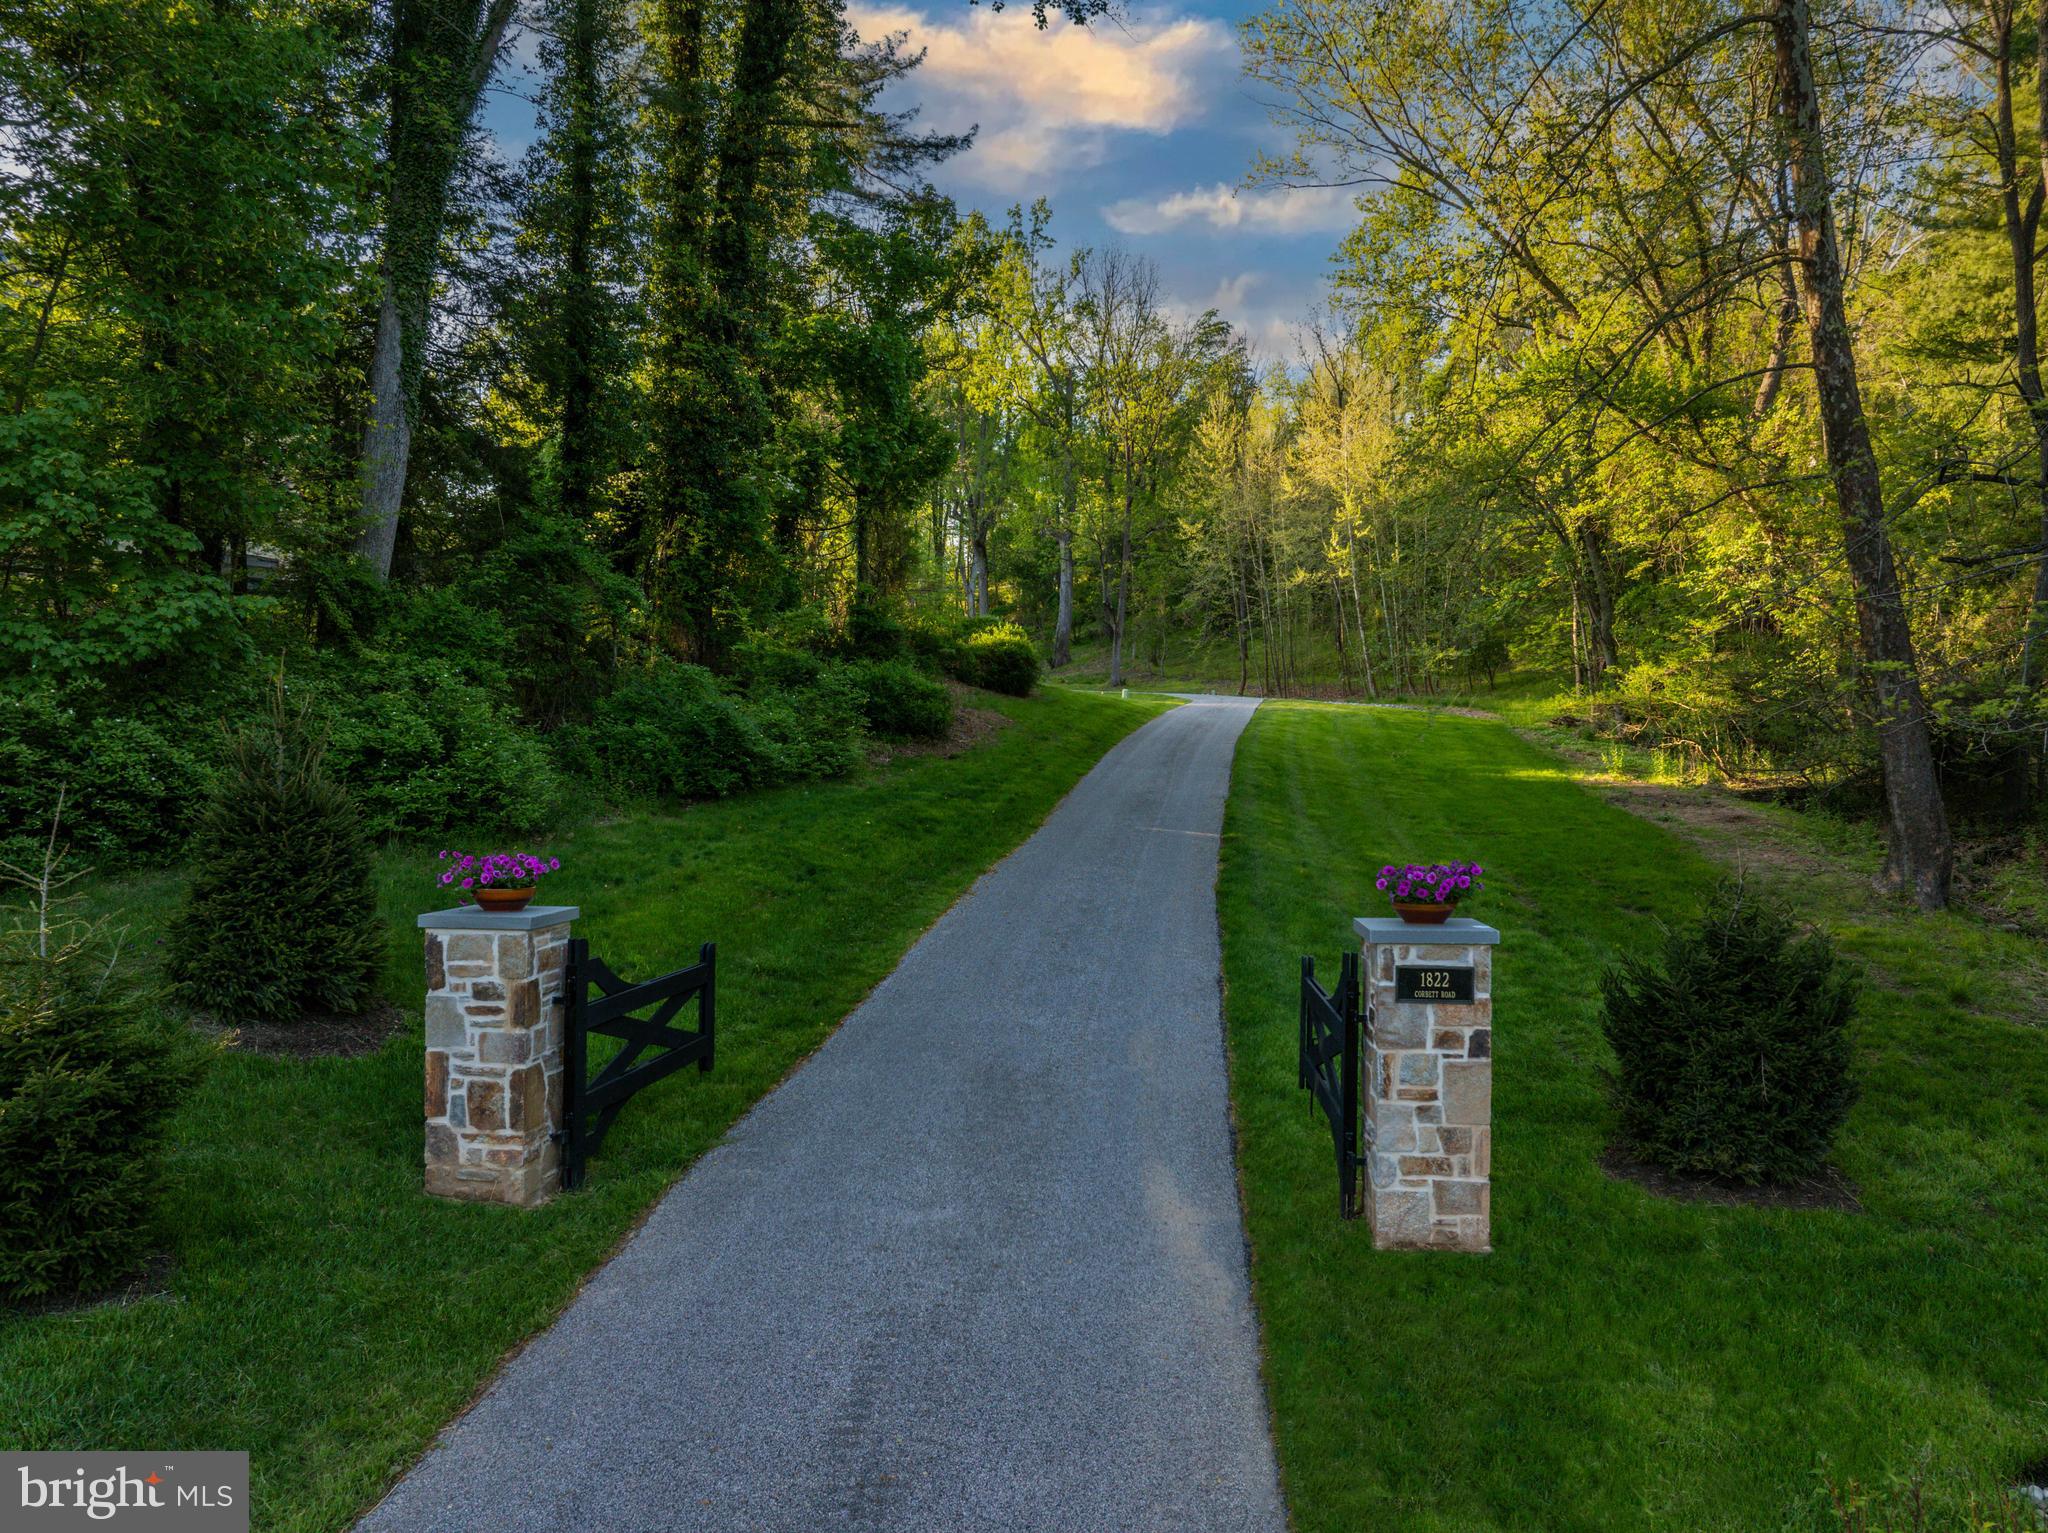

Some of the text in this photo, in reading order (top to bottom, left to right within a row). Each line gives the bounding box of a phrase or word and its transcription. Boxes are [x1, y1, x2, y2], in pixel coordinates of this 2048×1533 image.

[1420, 972, 1449, 987] 1822
[1414, 990, 1456, 999] CORBETT ROAD
